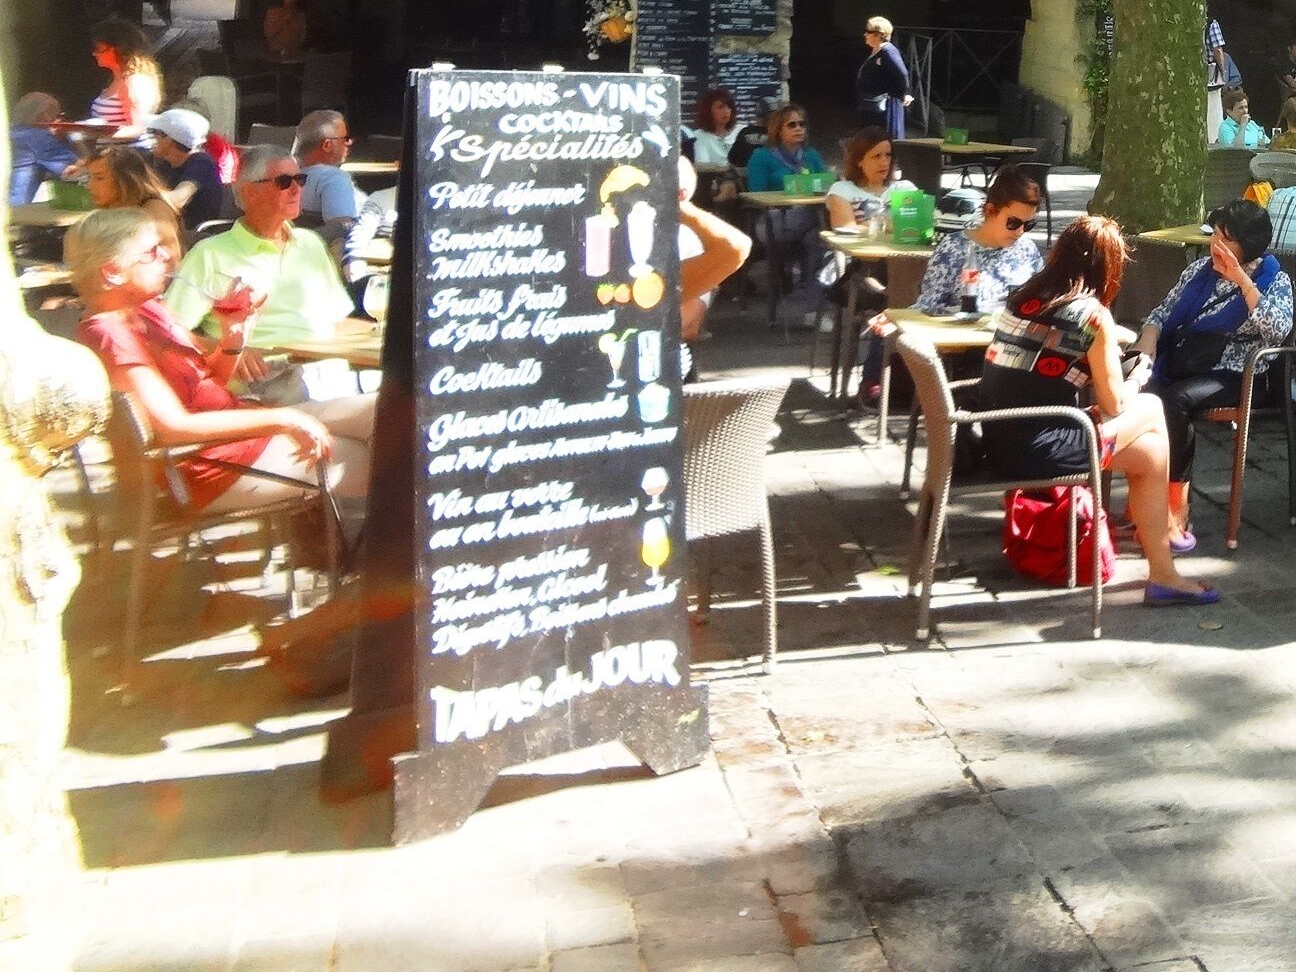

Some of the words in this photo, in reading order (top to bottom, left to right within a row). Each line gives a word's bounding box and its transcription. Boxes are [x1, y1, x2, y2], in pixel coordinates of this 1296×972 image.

[429, 80, 559, 117] BOISSONS
[579, 81, 668, 117] VINS
[498, 110, 624, 134] COCKTAILS
[450, 131, 643, 178] Spécialités
[428, 181, 494, 210] Petit
[493, 180, 587, 215] déjeuner
[429, 224, 544, 253] Smoothies
[427, 287, 503, 318] Fruits
[497, 284, 567, 321] frais
[501, 314, 531, 340] de
[531, 310, 616, 344] légumes
[427, 410, 508, 452] Glaces
[427, 488, 473, 520] Vin
[580, 639, 682, 694] JOUR
